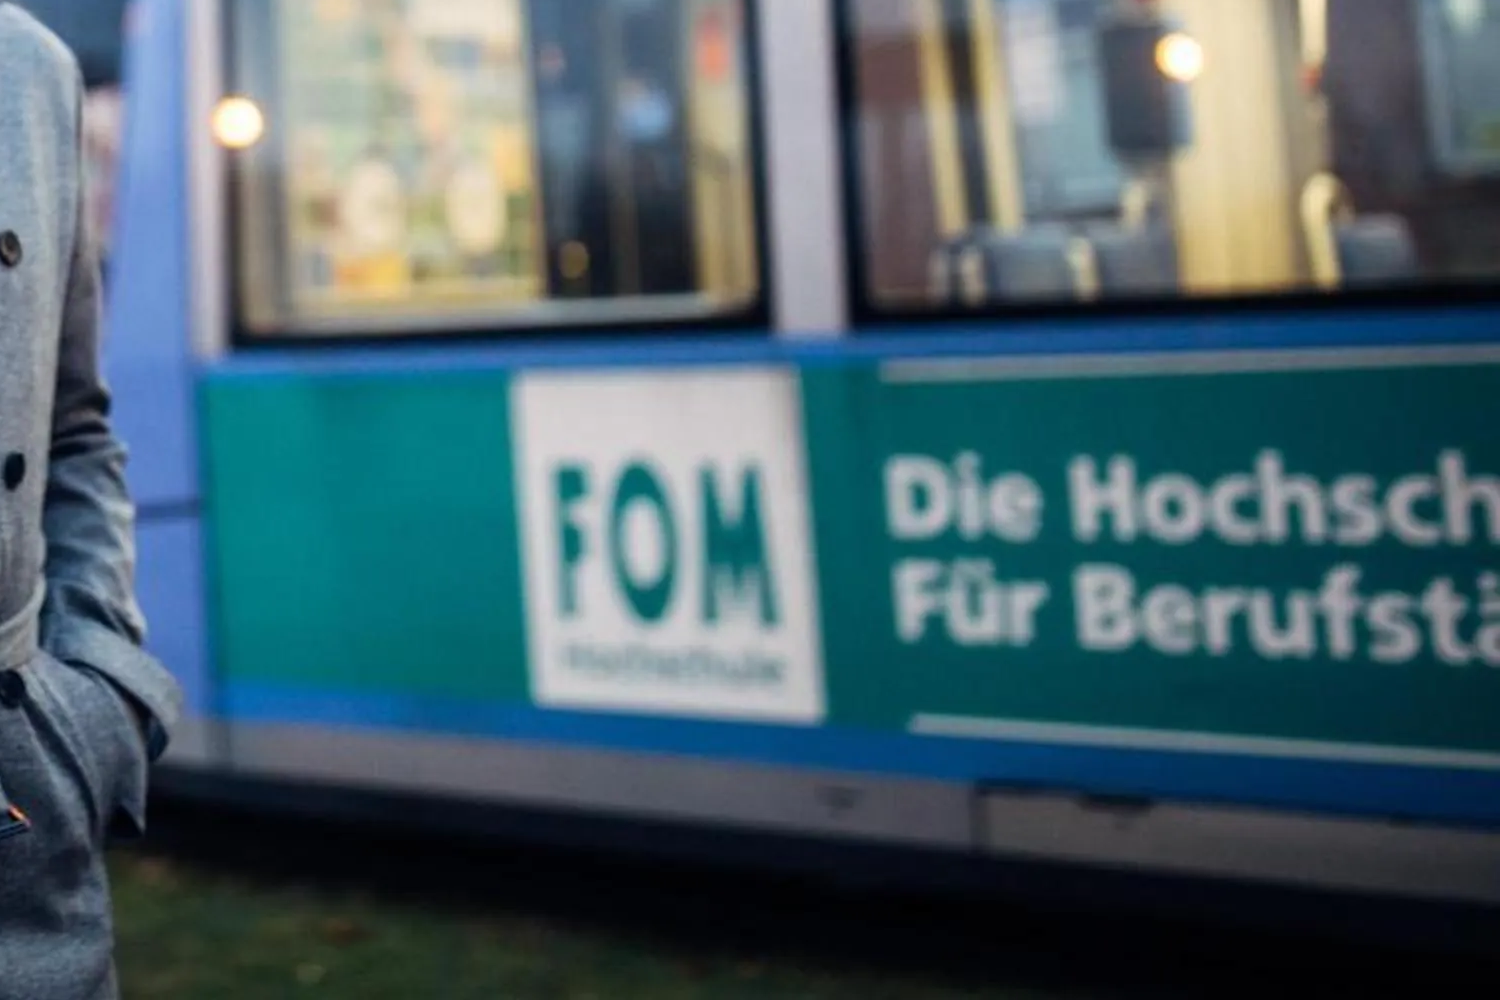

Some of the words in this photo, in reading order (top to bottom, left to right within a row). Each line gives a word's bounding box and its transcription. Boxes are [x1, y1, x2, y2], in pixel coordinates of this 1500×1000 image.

[886, 453, 1043, 541] Die
[1068, 450, 1500, 543] Hochsch
[555, 461, 780, 626] FOM
[894, 560, 1048, 645] Für
